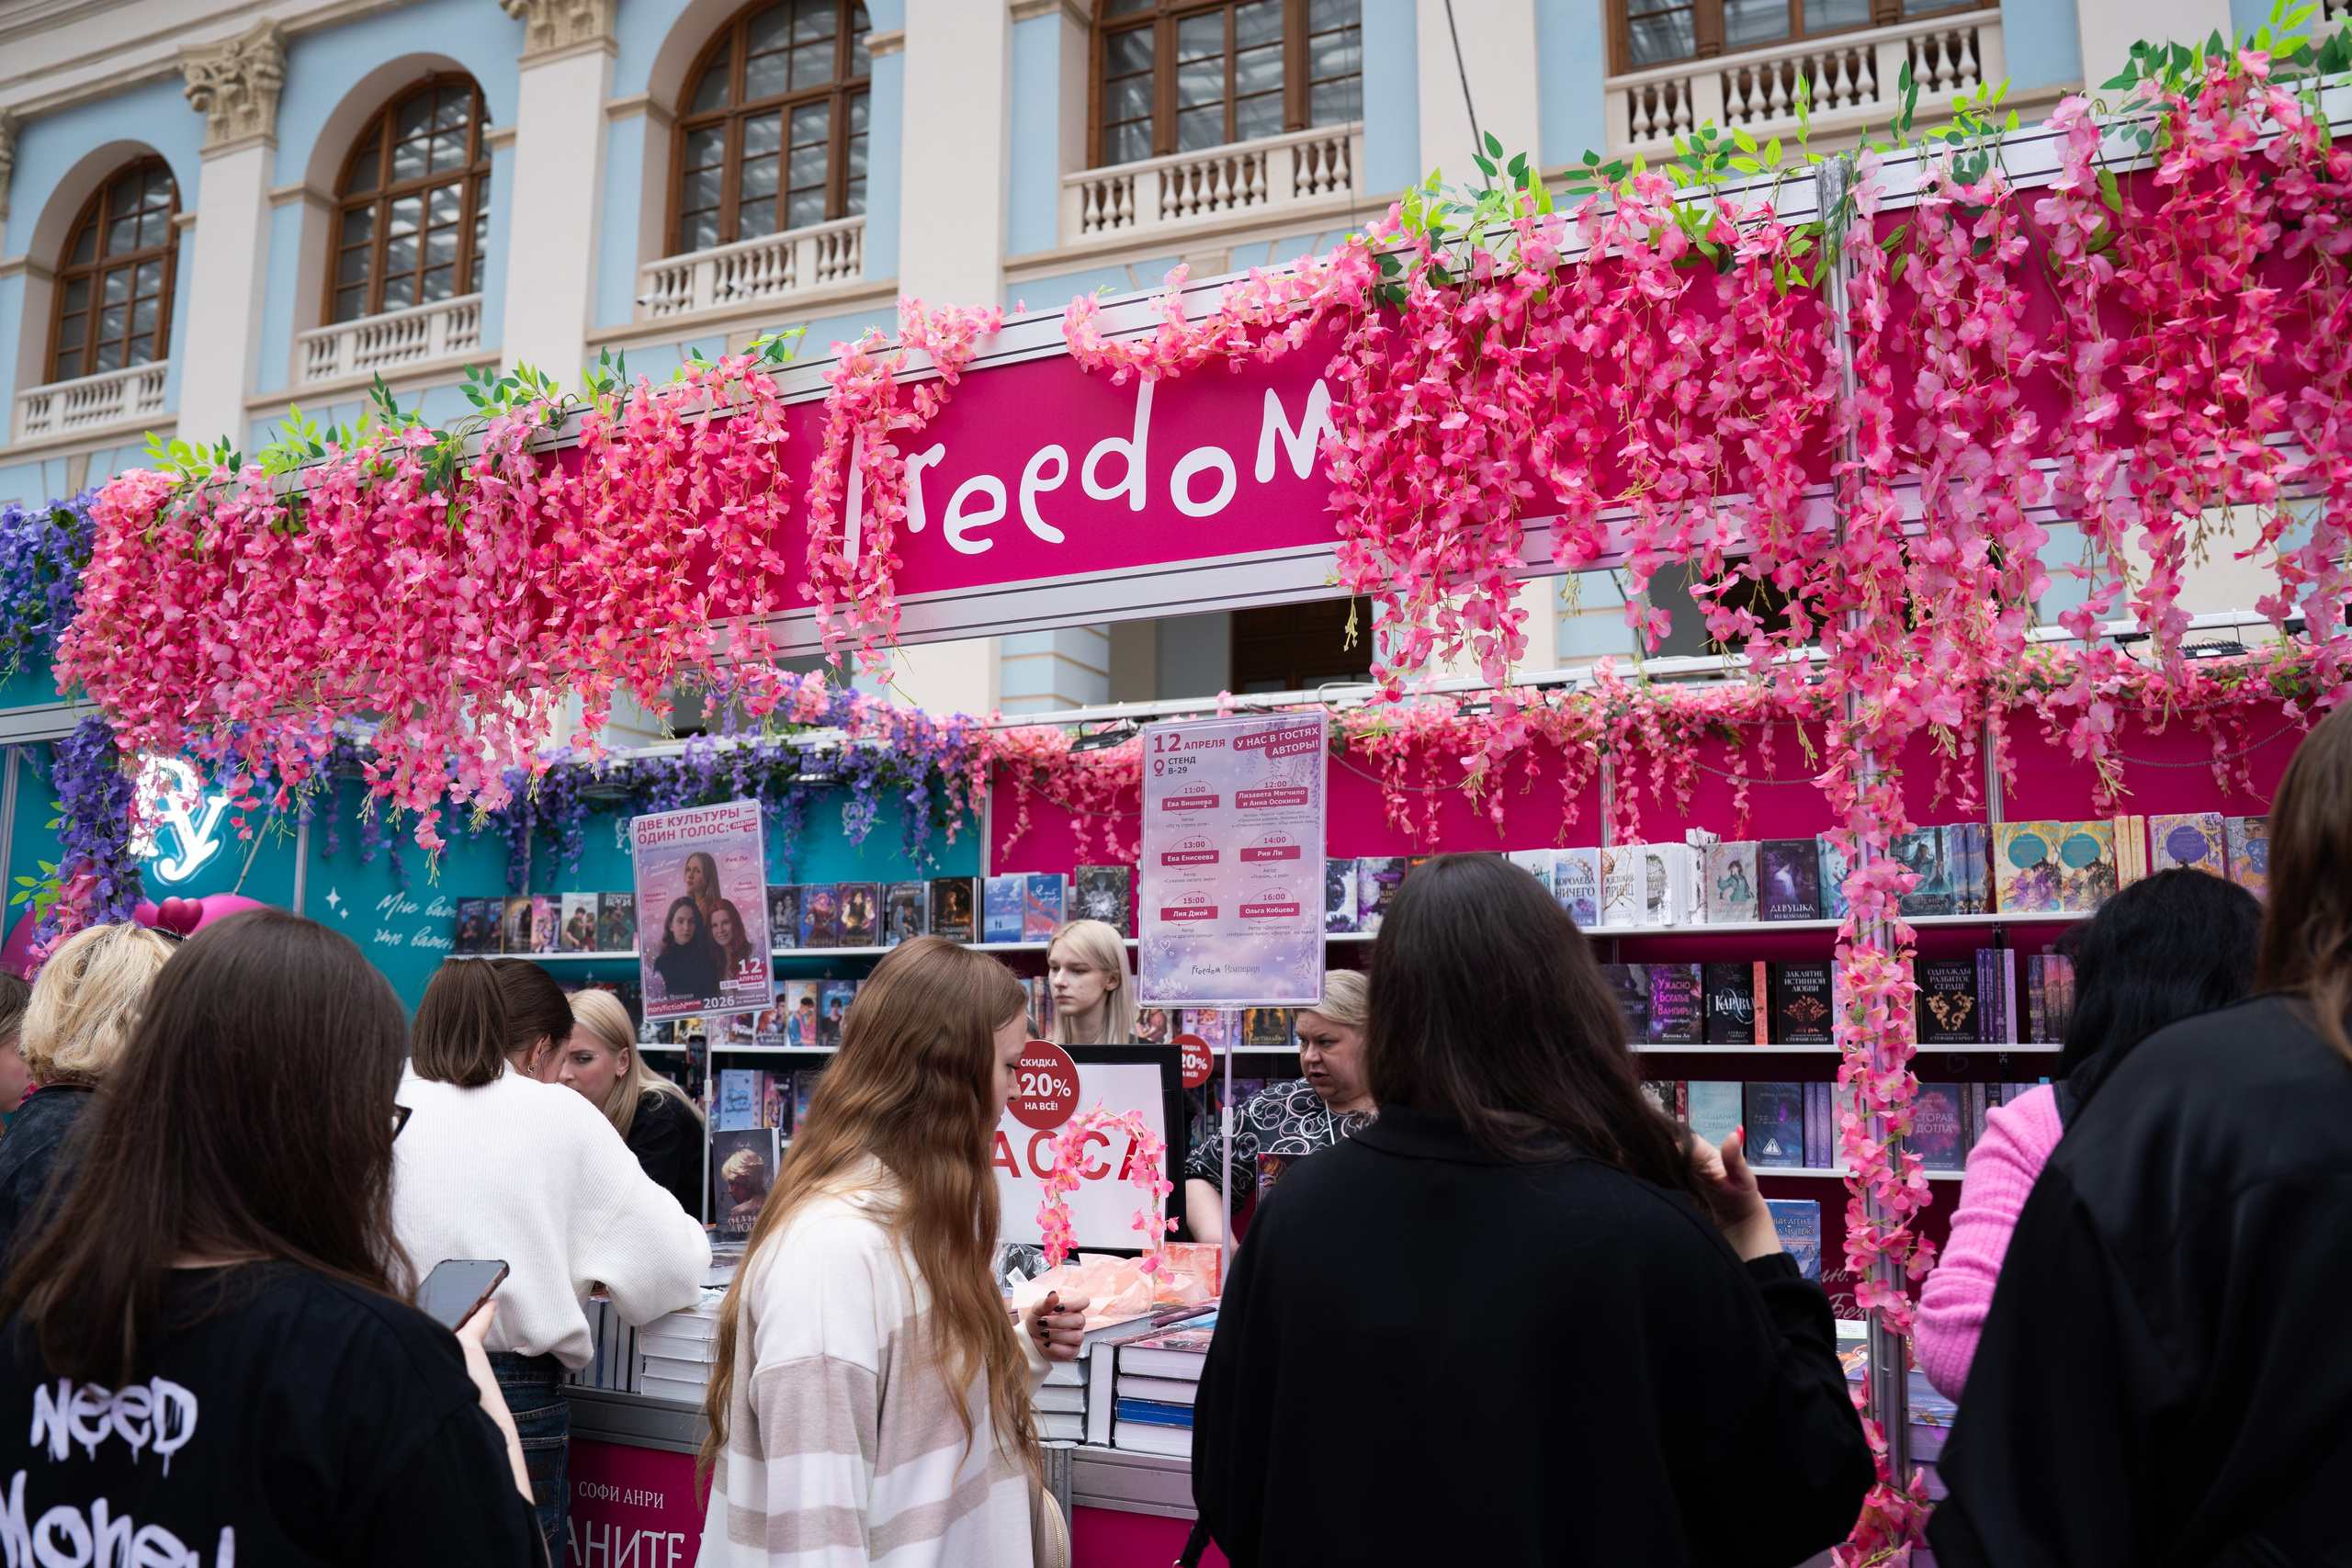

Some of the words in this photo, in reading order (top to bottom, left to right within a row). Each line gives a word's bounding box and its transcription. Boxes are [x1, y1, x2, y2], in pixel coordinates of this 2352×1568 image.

[1153, 733, 1182, 753] 12
[1183, 739, 1227, 750] АПРЕЛЯ
[1237, 739, 1244, 749] У
[1246, 736, 1268, 747] НАС
[1279, 726, 1319, 740] ГОСТЯХ
[1272, 739, 1319, 756] АВТОРЫ!
[1168, 756, 1196, 766] СТЕНД
[1168, 766, 1188, 775] В-29
[1264, 780, 1287, 788] 12:00
[1183, 785, 1206, 794] 11:00
[1273, 789, 1306, 797] Мягчило
[1269, 797, 1300, 806] Осокина
[637, 818, 663, 833] ДВЕ
[667, 807, 740, 828] КУЛЬТУРЫ
[638, 829, 676, 845] ОДИН
[680, 822, 729, 839] ГОЛОС:
[1183, 840, 1205, 849] 13:00
[1263, 836, 1286, 844] 14:00
[1555, 886, 1596, 898] НИЧЕГО
[1182, 897, 1205, 905] 15:00
[1262, 893, 1285, 901] 16:00
[1266, 907, 1295, 915] Кобцева
[1770, 904, 1815, 912] ДЕВУШКА
[1188, 908, 1208, 918] Джей
[738, 957, 763, 975] 12
[1785, 970, 1824, 978] ЗАКЛЯТИЕ
[1927, 967, 1972, 976] ОДНАЖДЫ
[738, 974, 763, 983] АПРЕЛЯ
[1783, 976, 1826, 986] ИСТИННОЙ
[1929, 975, 1971, 984] РАЗБИТОЕ
[1791, 985, 1819, 993] ЛЮБВИ
[1934, 983, 1966, 991] СЕРДЦЕ
[703, 995, 735, 1010] 2026
[1020, 1058, 1057, 1068] СКИДКА
[1024, 1101, 1039, 1111] НА
[1039, 1101, 1058, 1111] ВСЁ!
[1914, 1112, 1954, 1122] СГОРАЯ
[1916, 1123, 1953, 1134] ДОТЛА
[578, 1481, 620, 1504] СОФИ
[623, 1487, 664, 1510] АНРИ
